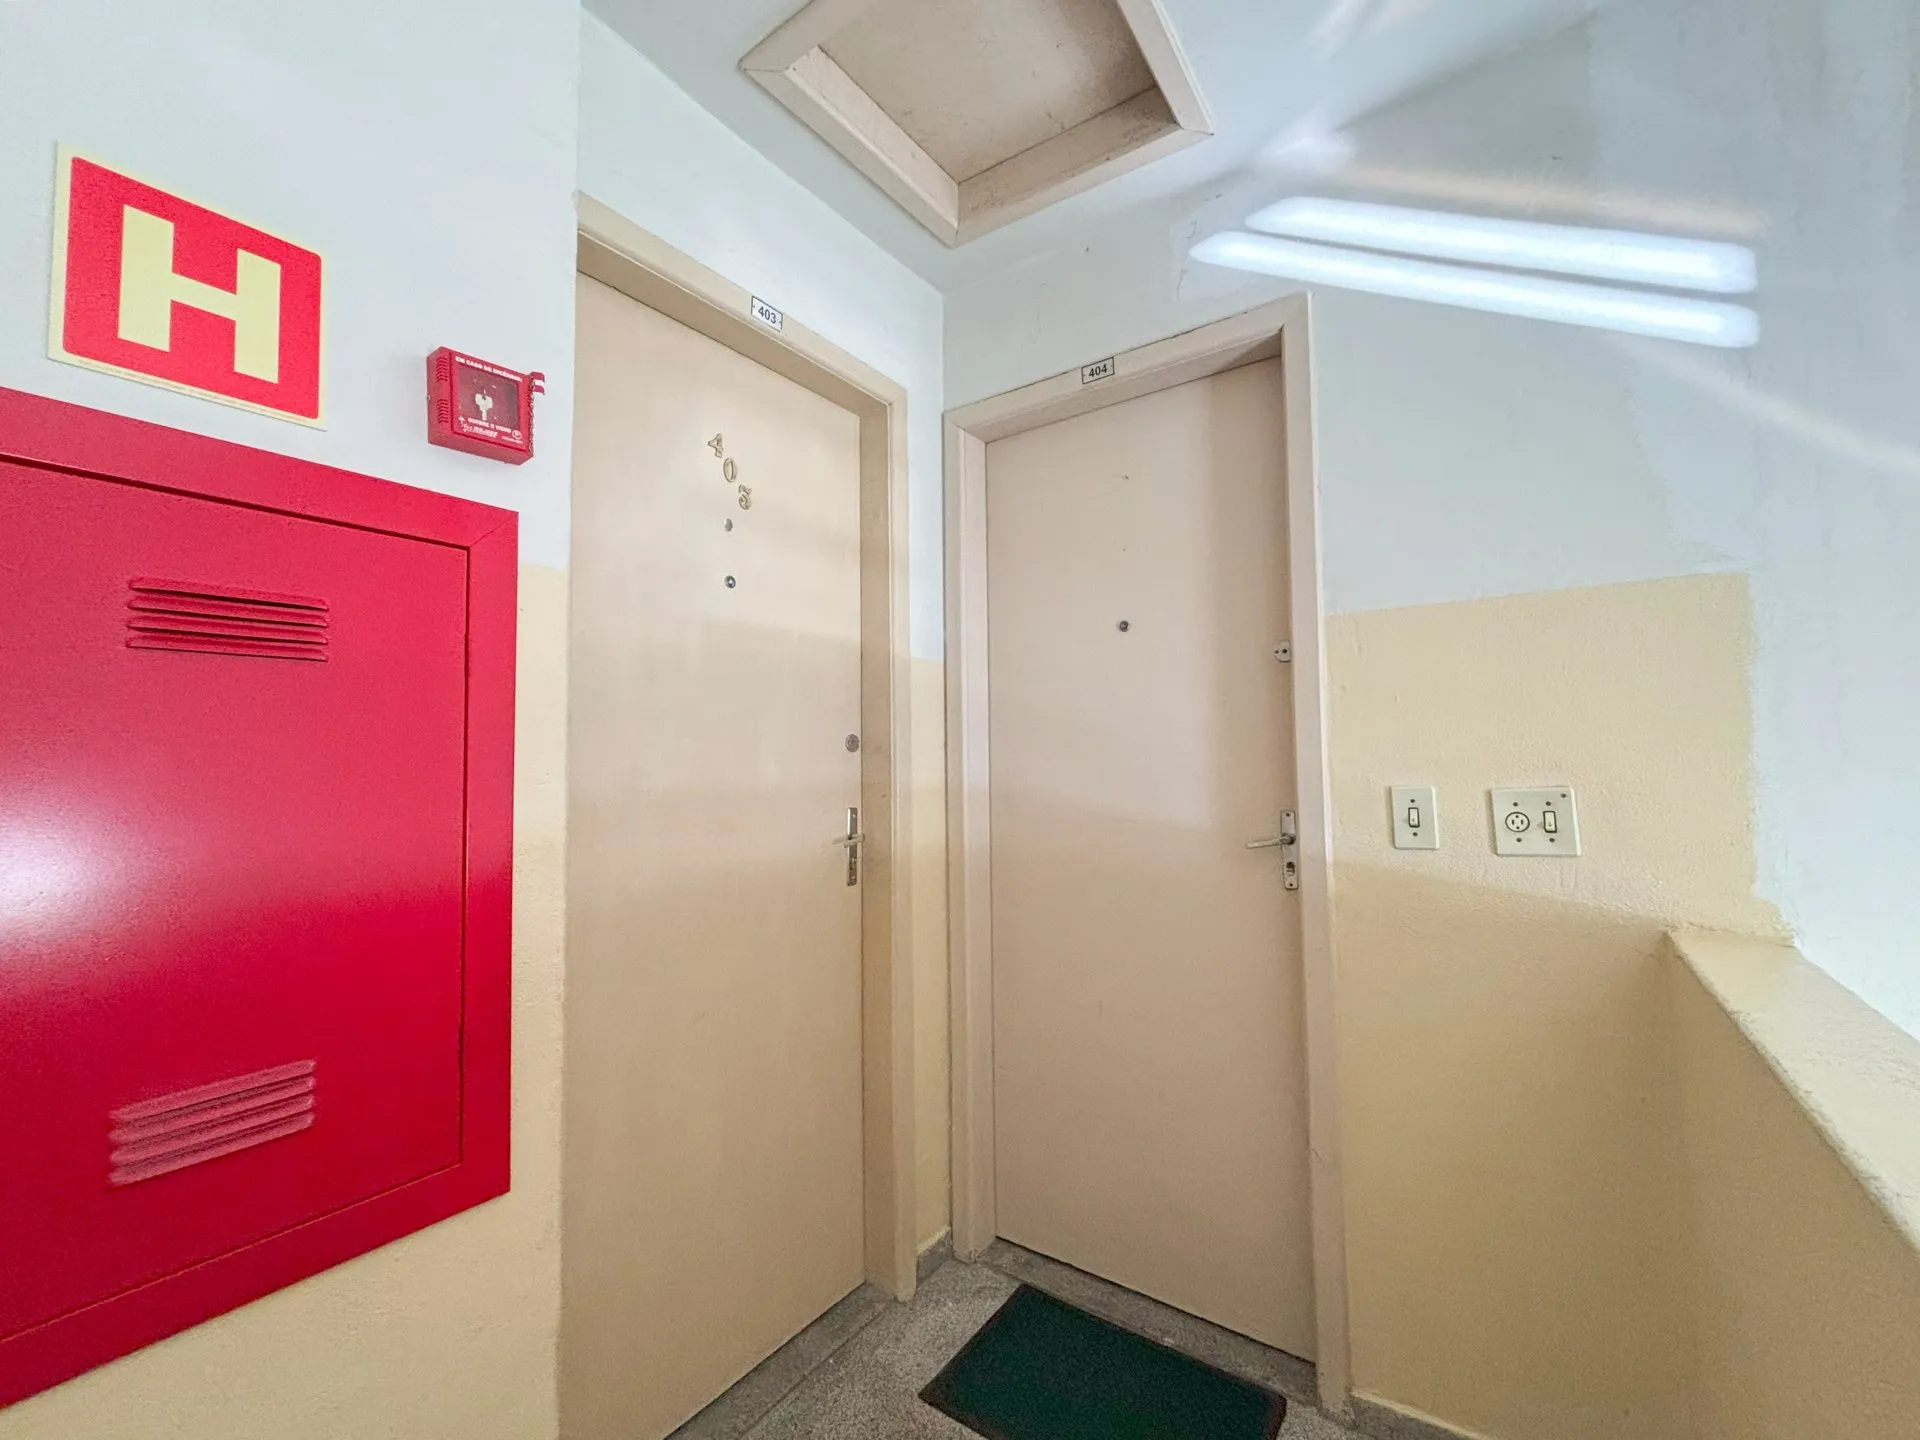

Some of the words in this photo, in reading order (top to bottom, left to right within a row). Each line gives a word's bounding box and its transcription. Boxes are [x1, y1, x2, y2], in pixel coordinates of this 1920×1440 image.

[117, 204, 281, 384] H
[758, 306, 777, 324] 403
[466, 359, 483, 369] CASO
[483, 365, 492, 373] DE
[1089, 363, 1108, 377] 404
